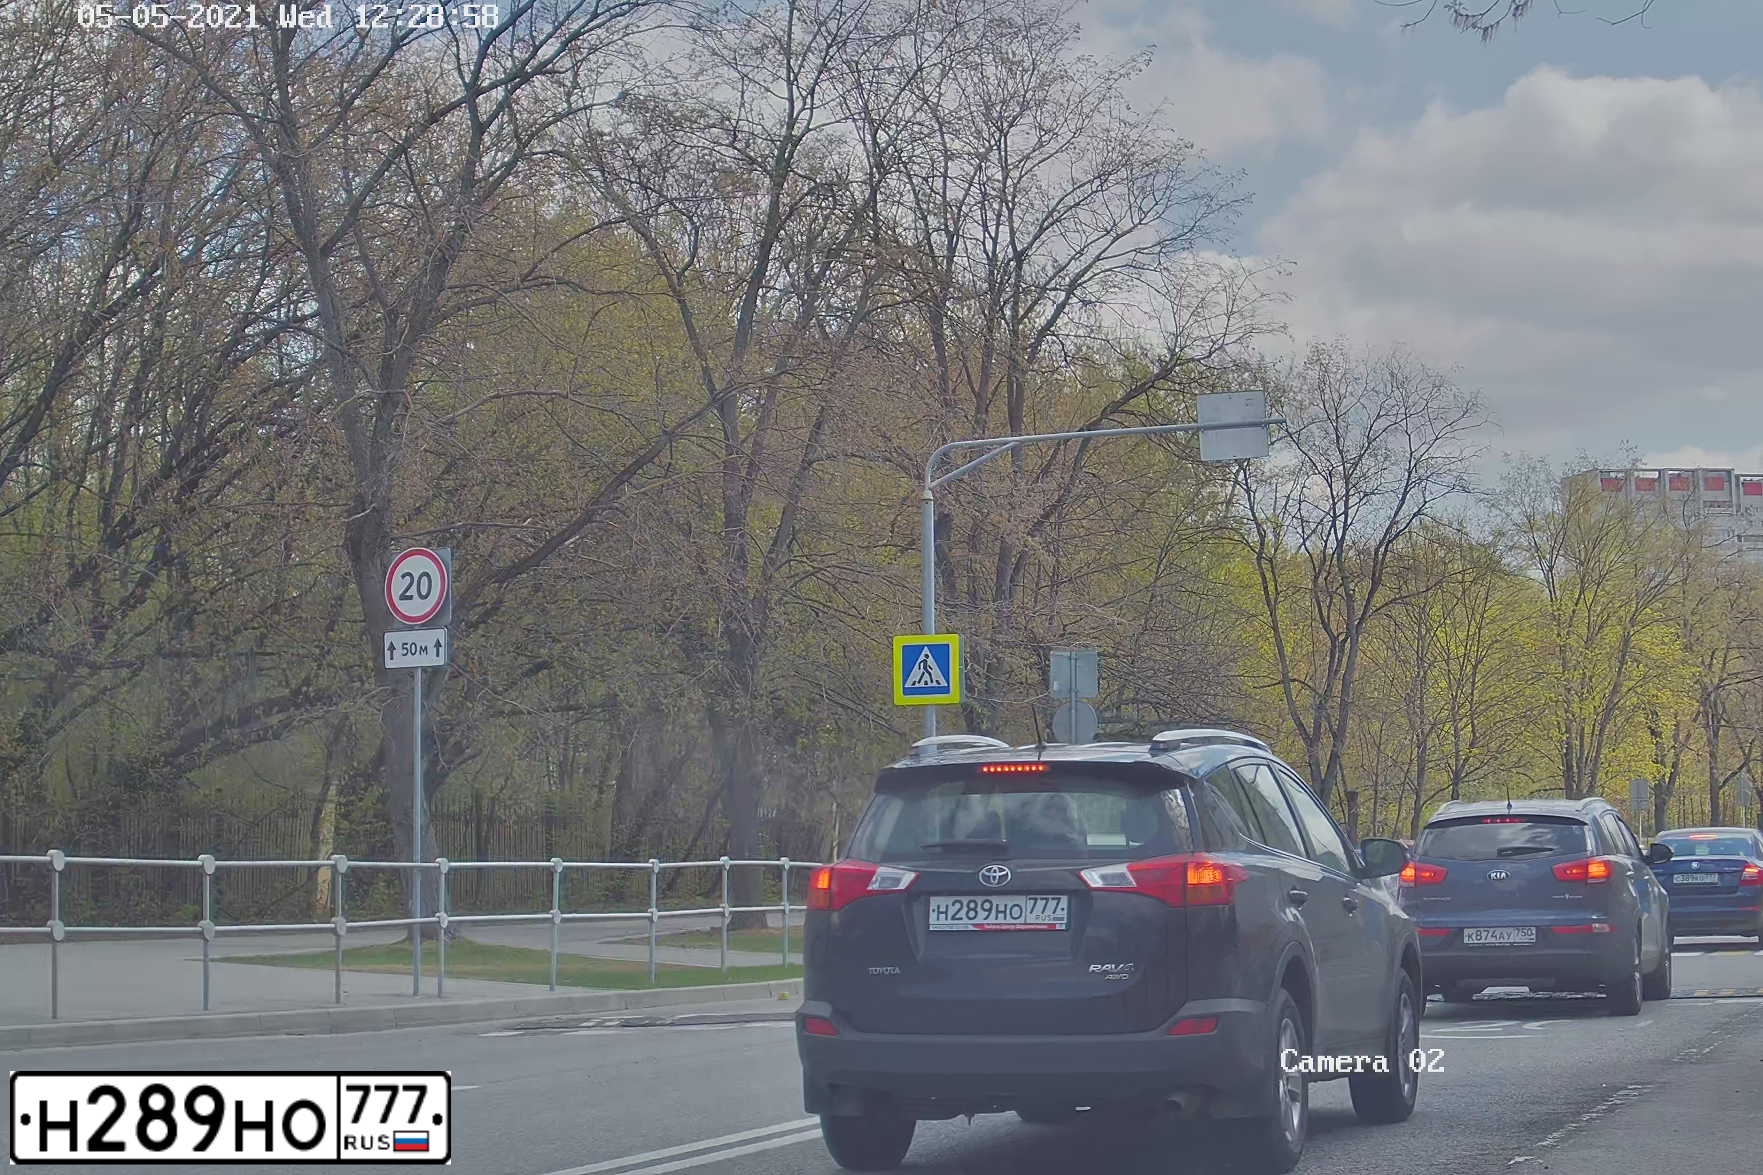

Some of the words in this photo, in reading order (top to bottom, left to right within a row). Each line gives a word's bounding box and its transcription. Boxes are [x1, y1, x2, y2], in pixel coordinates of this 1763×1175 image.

[398, 571, 432, 601] 20
[1490, 871, 1507, 880] KIA
[1028, 897, 1061, 914] 777
[1515, 928, 1533, 937] 750
[868, 967, 900, 975] TOYOTA
[1089, 963, 1134, 973] RAV4
